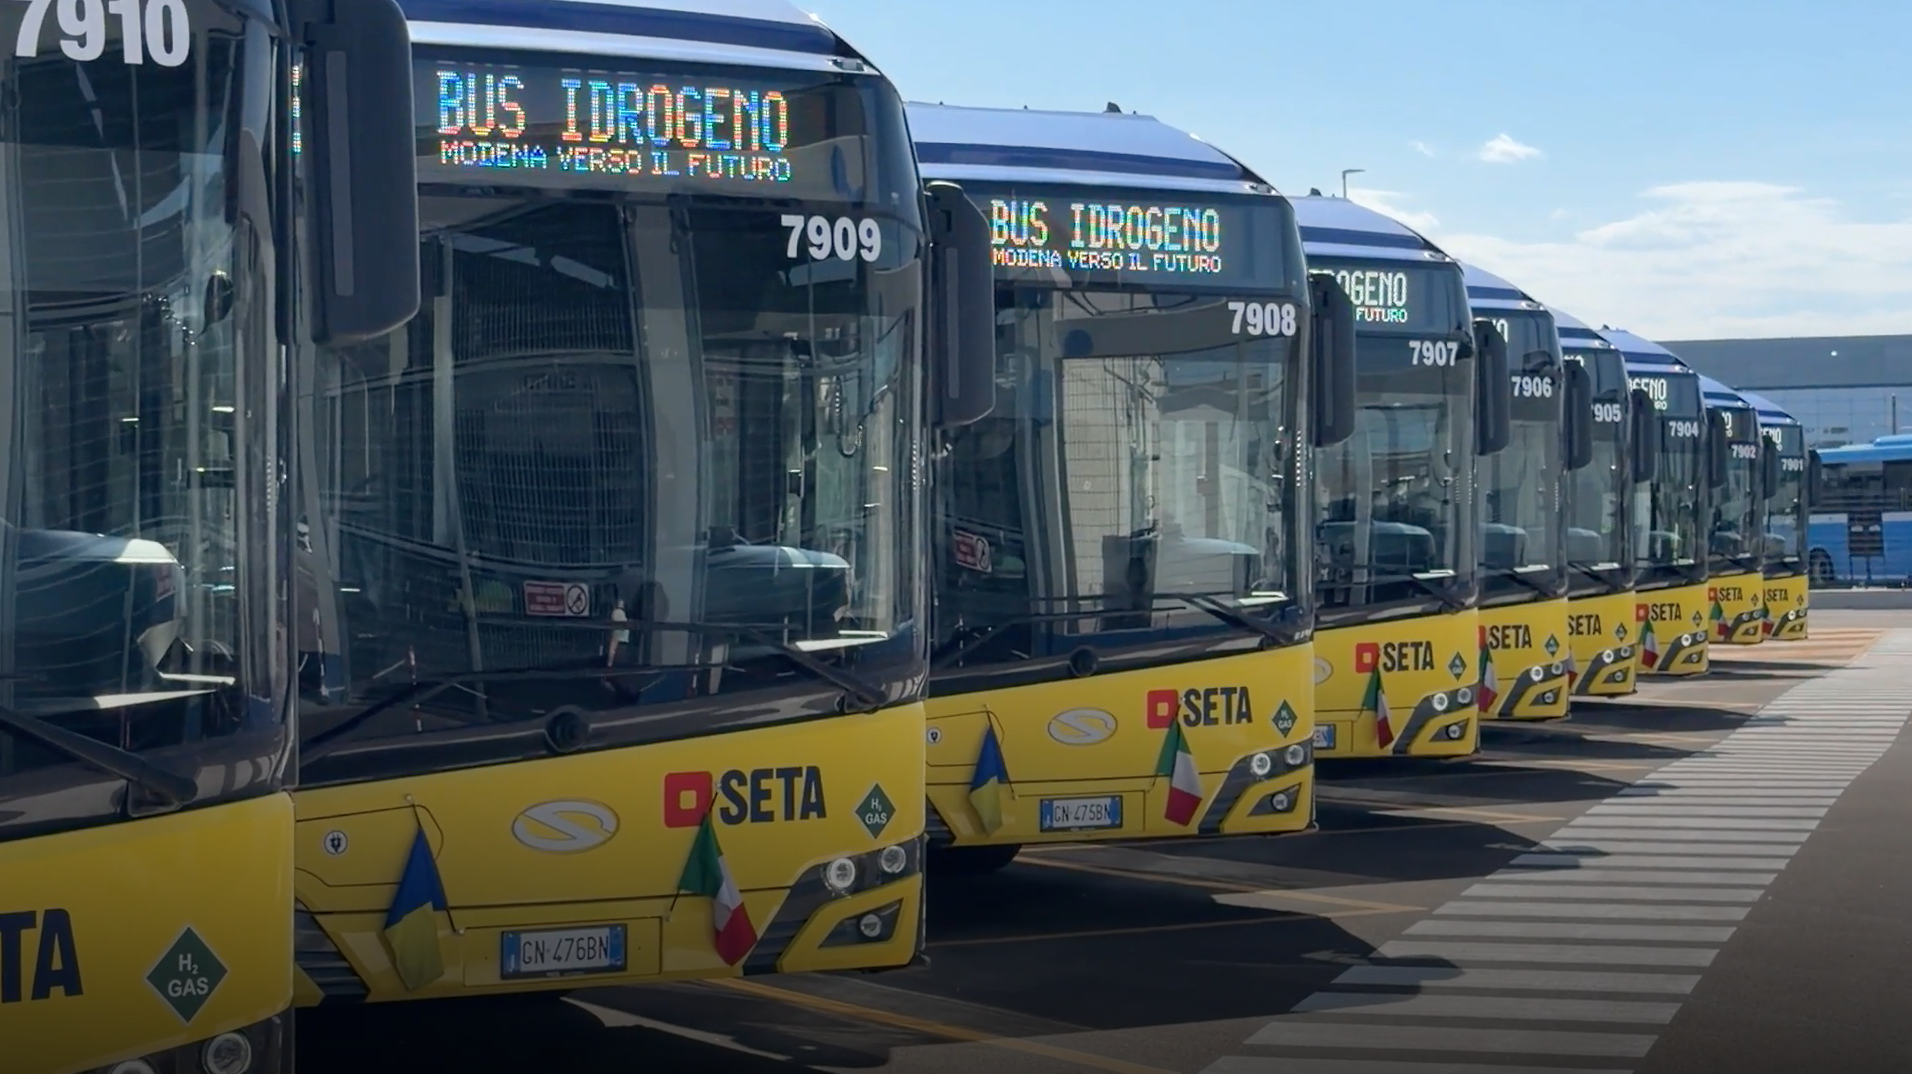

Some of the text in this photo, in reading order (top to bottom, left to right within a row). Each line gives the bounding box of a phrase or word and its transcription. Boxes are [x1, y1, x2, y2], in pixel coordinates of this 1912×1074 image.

[16, 0, 190, 67] 7910
[437, 70, 789, 153] BUS IDROGENO
[440, 140, 791, 182] MODENA VERSO IL FUTURO
[780, 213, 882, 263] 7909
[991, 198, 1221, 252] BUS IDROGENO
[991, 248, 1222, 273] MODENA VERSO IL FUTURO
[1309, 269, 1408, 307] OGENO
[1228, 301, 1297, 336] 7908
[1355, 307, 1408, 323] FUTURO
[1409, 340, 1459, 367] 7907
[1511, 376, 1553, 398] 7906
[1591, 403, 1622, 422] 905
[1668, 421, 1699, 438] 7904
[1719, 587, 1744, 602] SETA
[1766, 588, 1789, 602] SETA
[1568, 614, 1602, 636] SETA
[1651, 603, 1682, 622] SETA
[1489, 624, 1533, 650] SETA
[1382, 641, 1435, 673] SETA
[1183, 686, 1253, 728] SETA
[720, 765, 827, 826] SETA
[865, 812, 888, 825] GAS
[0, 908, 84, 1003] TA
[167, 976, 209, 998] GAS
